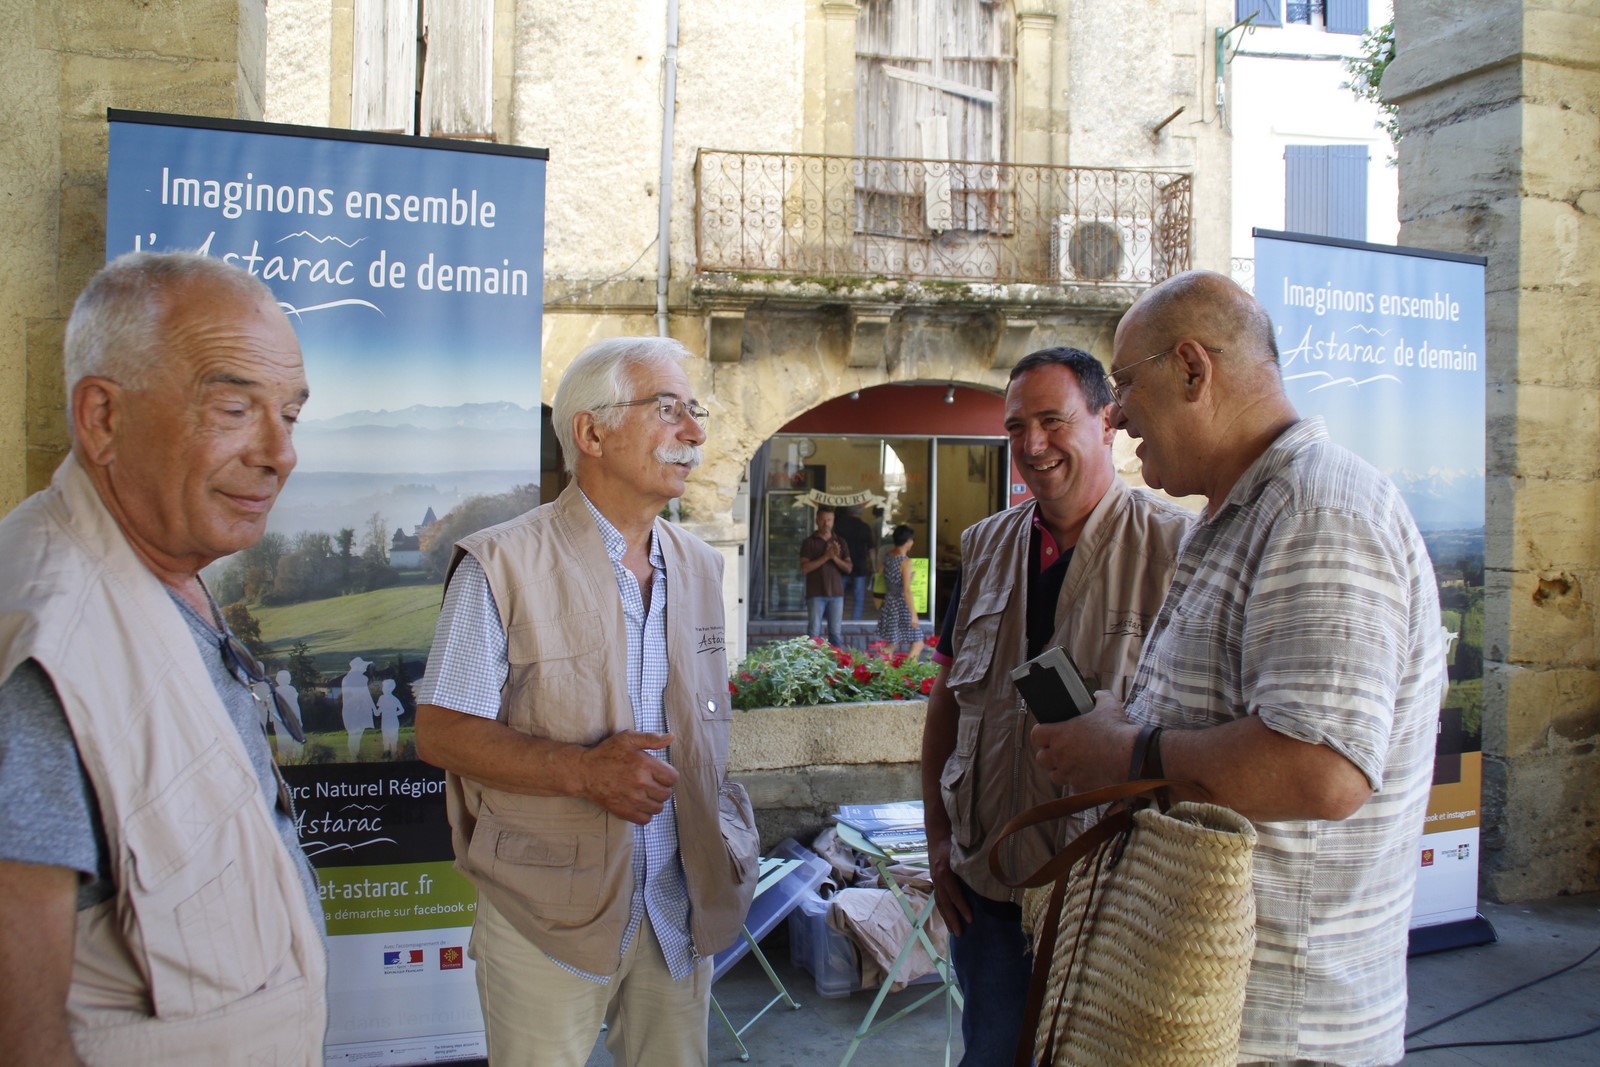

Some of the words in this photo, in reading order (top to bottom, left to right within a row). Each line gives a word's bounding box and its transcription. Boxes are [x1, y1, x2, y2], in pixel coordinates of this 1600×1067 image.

[161, 167, 334, 219] Imaginons
[345, 188, 496, 228] ensemble
[369, 250, 405, 288] de
[417, 253, 528, 296] demain
[1284, 277, 1374, 316] Imaginons
[1379, 293, 1460, 321] ensemble
[1394, 338, 1414, 366] de
[1418, 340, 1477, 371] demain
[814, 492, 868, 505] RICOURT
[291, 786, 310, 799] rc
[316, 779, 383, 798] Naturel
[389, 778, 447, 798] Région
[1447, 810, 1477, 820] instagram
[335, 907, 391, 920] démarche
[394, 907, 411, 916] sur
[414, 902, 464, 915] facebook
